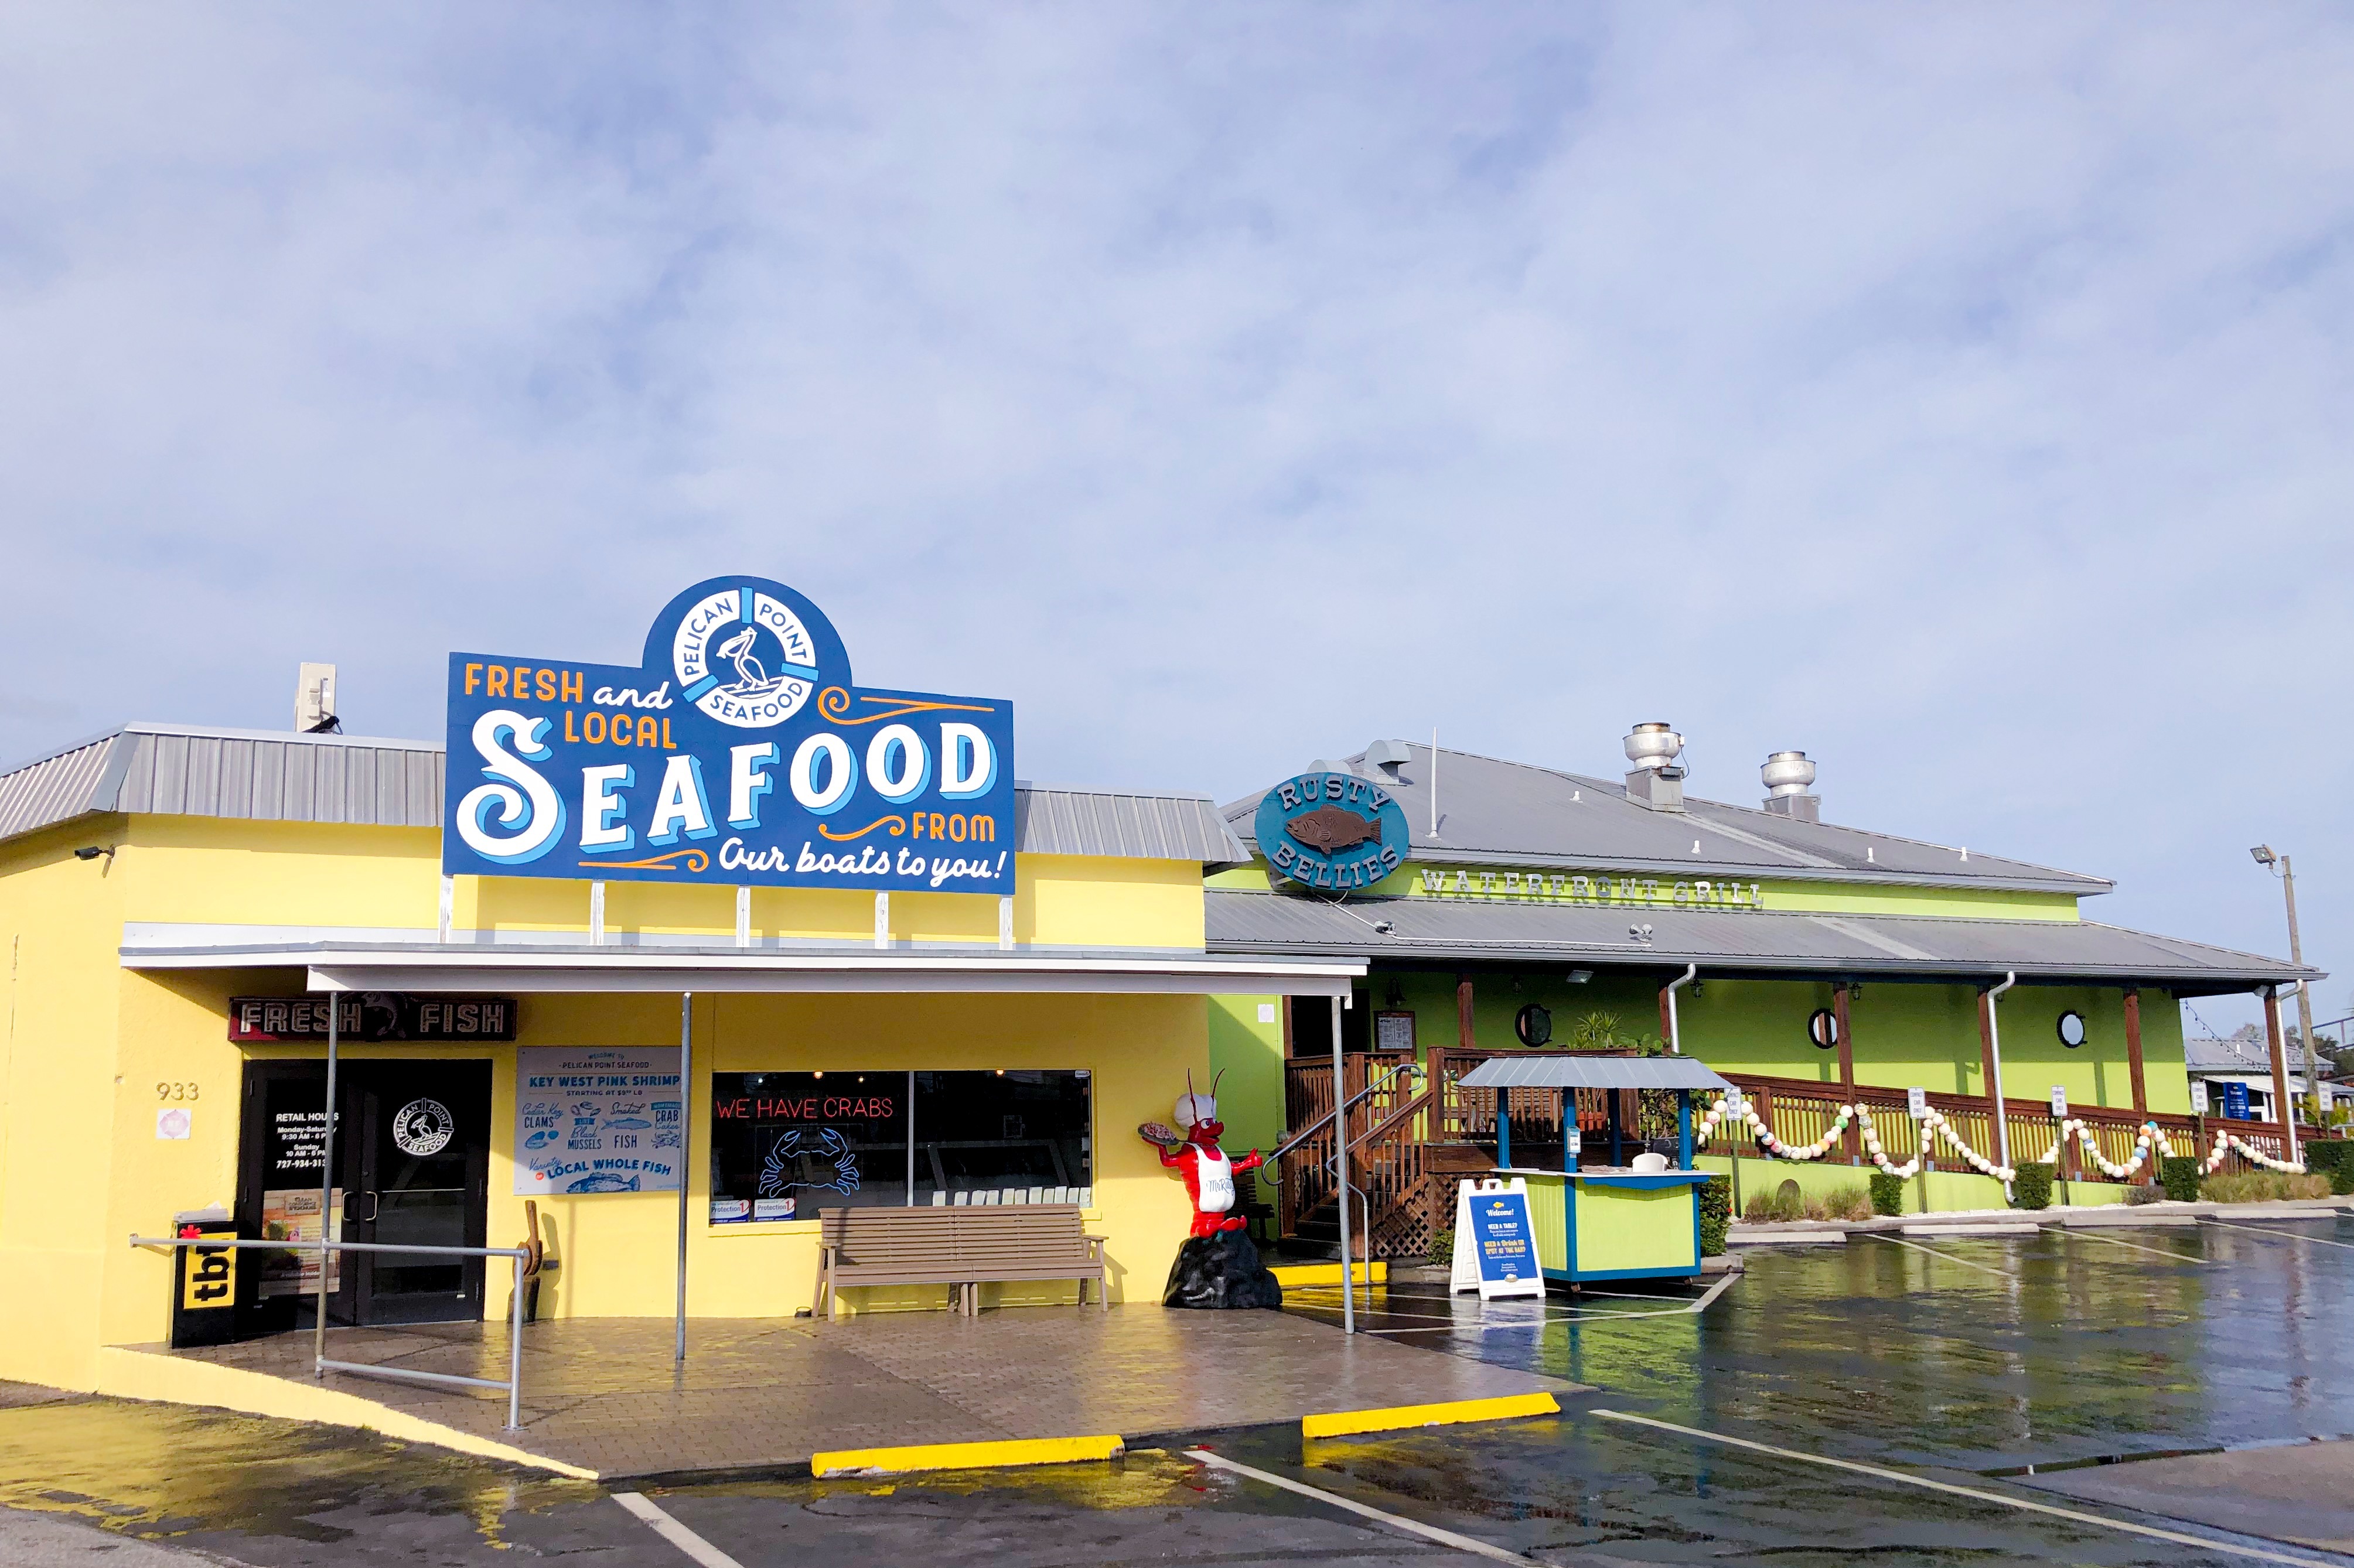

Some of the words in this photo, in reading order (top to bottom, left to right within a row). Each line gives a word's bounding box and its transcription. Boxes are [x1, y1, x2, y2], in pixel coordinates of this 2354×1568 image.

[684, 597, 734, 676] PELICAN
[759, 603, 807, 659] POINT
[465, 662, 584, 703] FRESH
[593, 681, 673, 709] and
[709, 682, 803, 722] SEAFOOD
[564, 710, 677, 749] LOCAL
[456, 709, 998, 864] SEAFOOD
[1277, 774, 1391, 813] RUSTY
[913, 812, 995, 842] FROM
[719, 836, 790, 872] Our
[796, 841, 891, 876] boats
[896, 846, 926, 876] to
[930, 850, 1007, 887] you!
[1272, 841, 1400, 887] BELLIES
[1421, 869, 1659, 900] WATERFRONT
[1673, 880, 1763, 905] GRILL
[240, 1003, 361, 1033] FRESH
[420, 1004, 503, 1033] FISH
[529, 1077, 554, 1087] KEY
[558, 1076, 593, 1088] WEST
[597, 1076, 628, 1087] PINK
[632, 1075, 680, 1087] SHRIMP
[156, 1082, 199, 1101] 933
[276, 1113, 306, 1122] RETAIL
[308, 1112, 339, 1121] HOUS
[522, 1103, 546, 1115] Cedar
[610, 1102, 646, 1115] Smoked
[656, 1110, 678, 1122] CRAB
[717, 1098, 750, 1118] WE
[757, 1098, 818, 1118] HAVE
[824, 1098, 893, 1118] CRABS
[277, 1126, 337, 1134] Monday-Satury
[397, 1104, 418, 1138] PELICAN
[428, 1104, 449, 1125] POINT
[524, 1116, 554, 1128] CLAMS
[571, 1125, 598, 1139] Black
[408, 1134, 446, 1152] SEAFOOD
[568, 1138, 602, 1150] MUSSELS
[614, 1135, 637, 1149] FISH
[277, 1159, 326, 1169] 727-934-313
[547, 1161, 589, 1180] LOCAL
[593, 1159, 639, 1170] WHOLE
[643, 1161, 671, 1176] FISH
[1486, 1208, 1514, 1217] Welcome!
